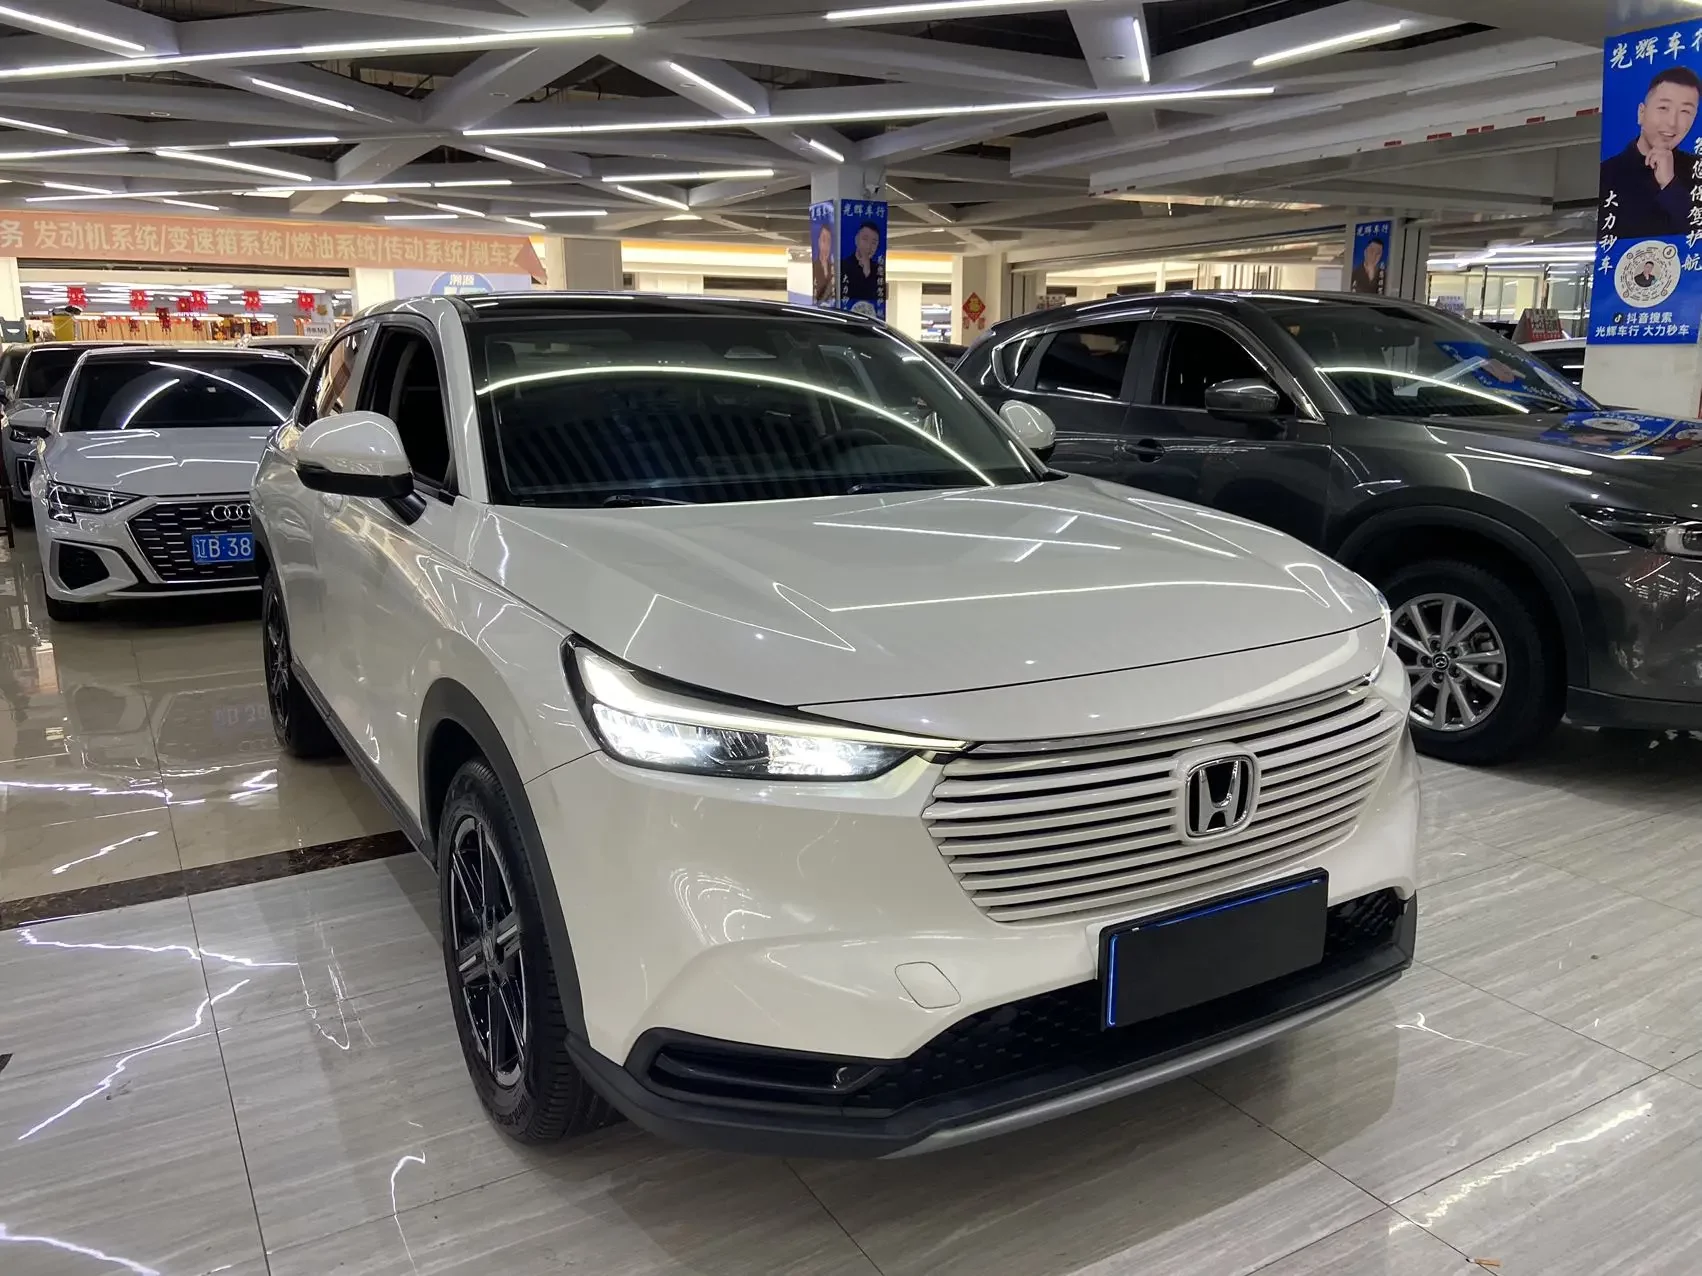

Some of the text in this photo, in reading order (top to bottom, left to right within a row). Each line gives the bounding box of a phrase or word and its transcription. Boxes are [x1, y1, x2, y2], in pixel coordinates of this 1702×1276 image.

[0, 219, 24, 248] 务
[1598, 190, 1619, 275] 大力秒车
[1626, 311, 1673, 325] 抖音搜索
[1595, 324, 1690, 338] 光辉车行 大力秒车
